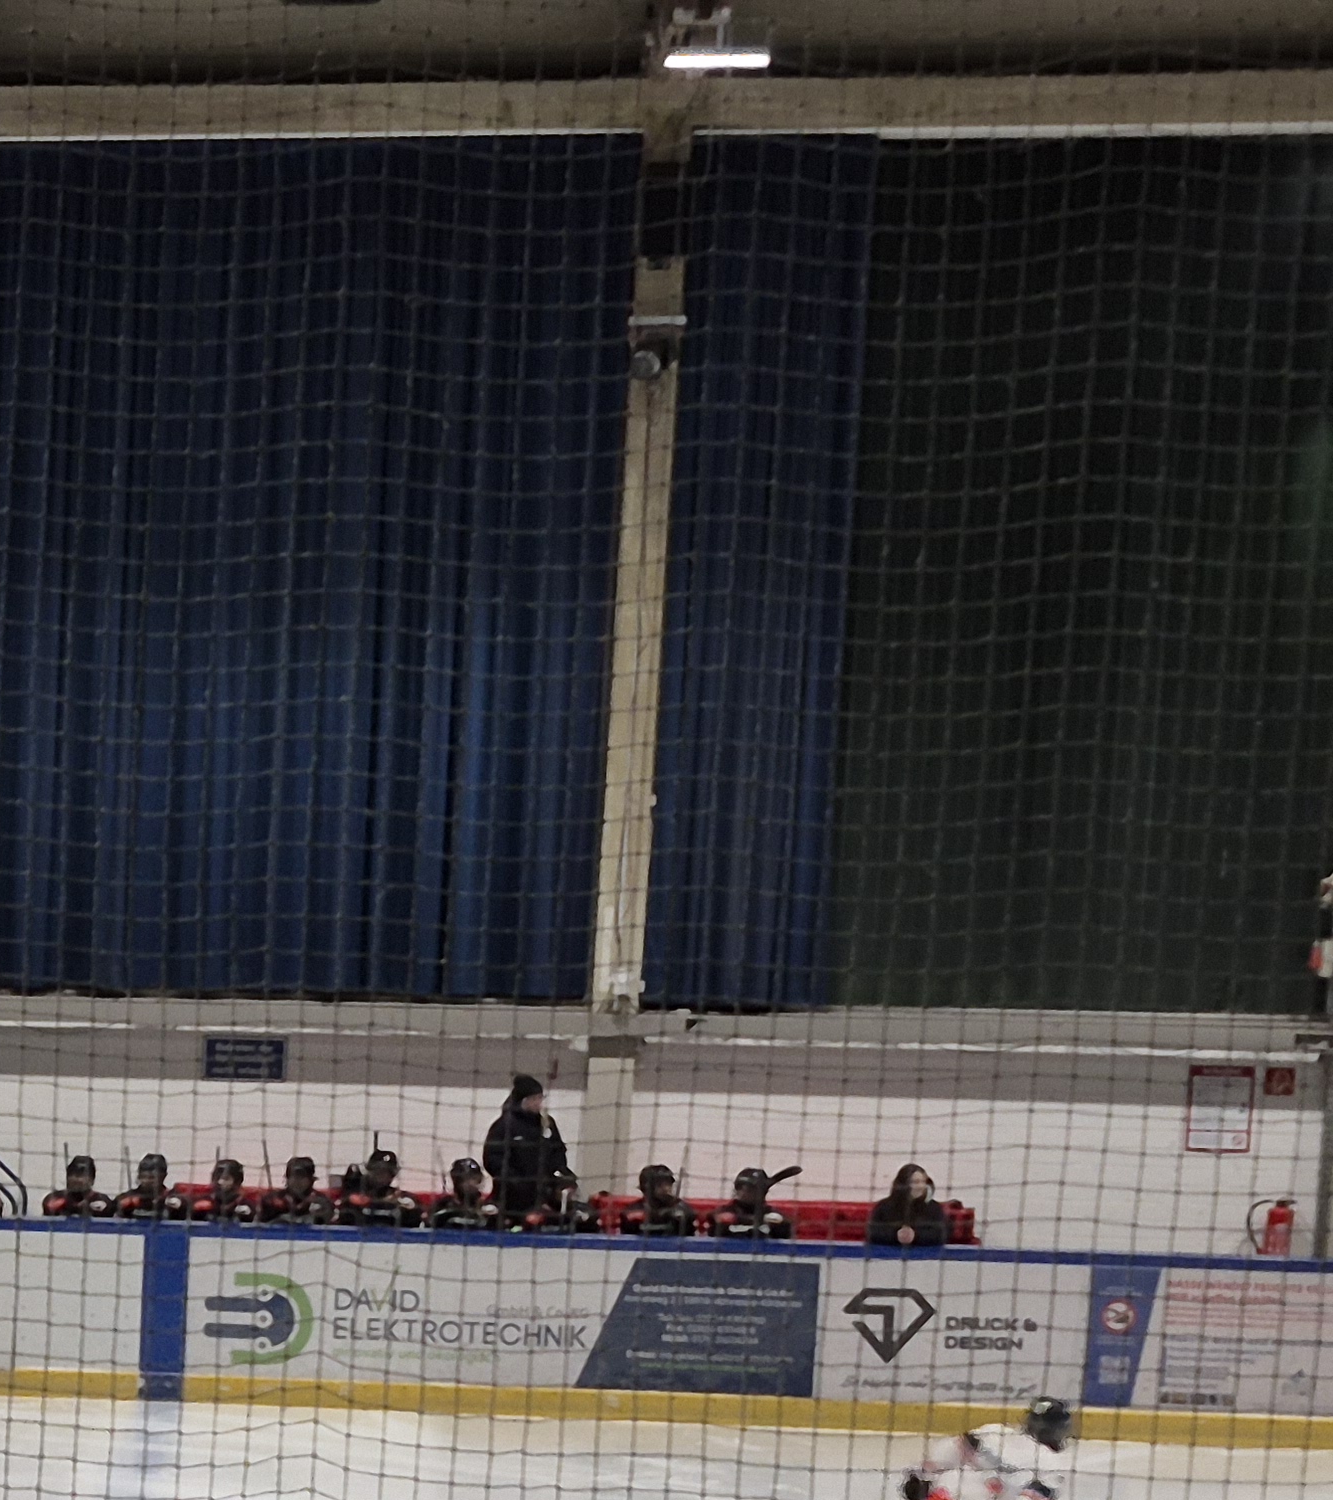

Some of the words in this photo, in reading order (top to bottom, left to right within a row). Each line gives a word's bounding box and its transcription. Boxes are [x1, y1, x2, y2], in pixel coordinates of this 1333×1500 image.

[334, 1288, 421, 1313] DAVID
[333, 1317, 586, 1348] ELEKTROTECHNIK
[945, 1316, 1018, 1331] DRUCK
[944, 1336, 1024, 1351] DESIGN
